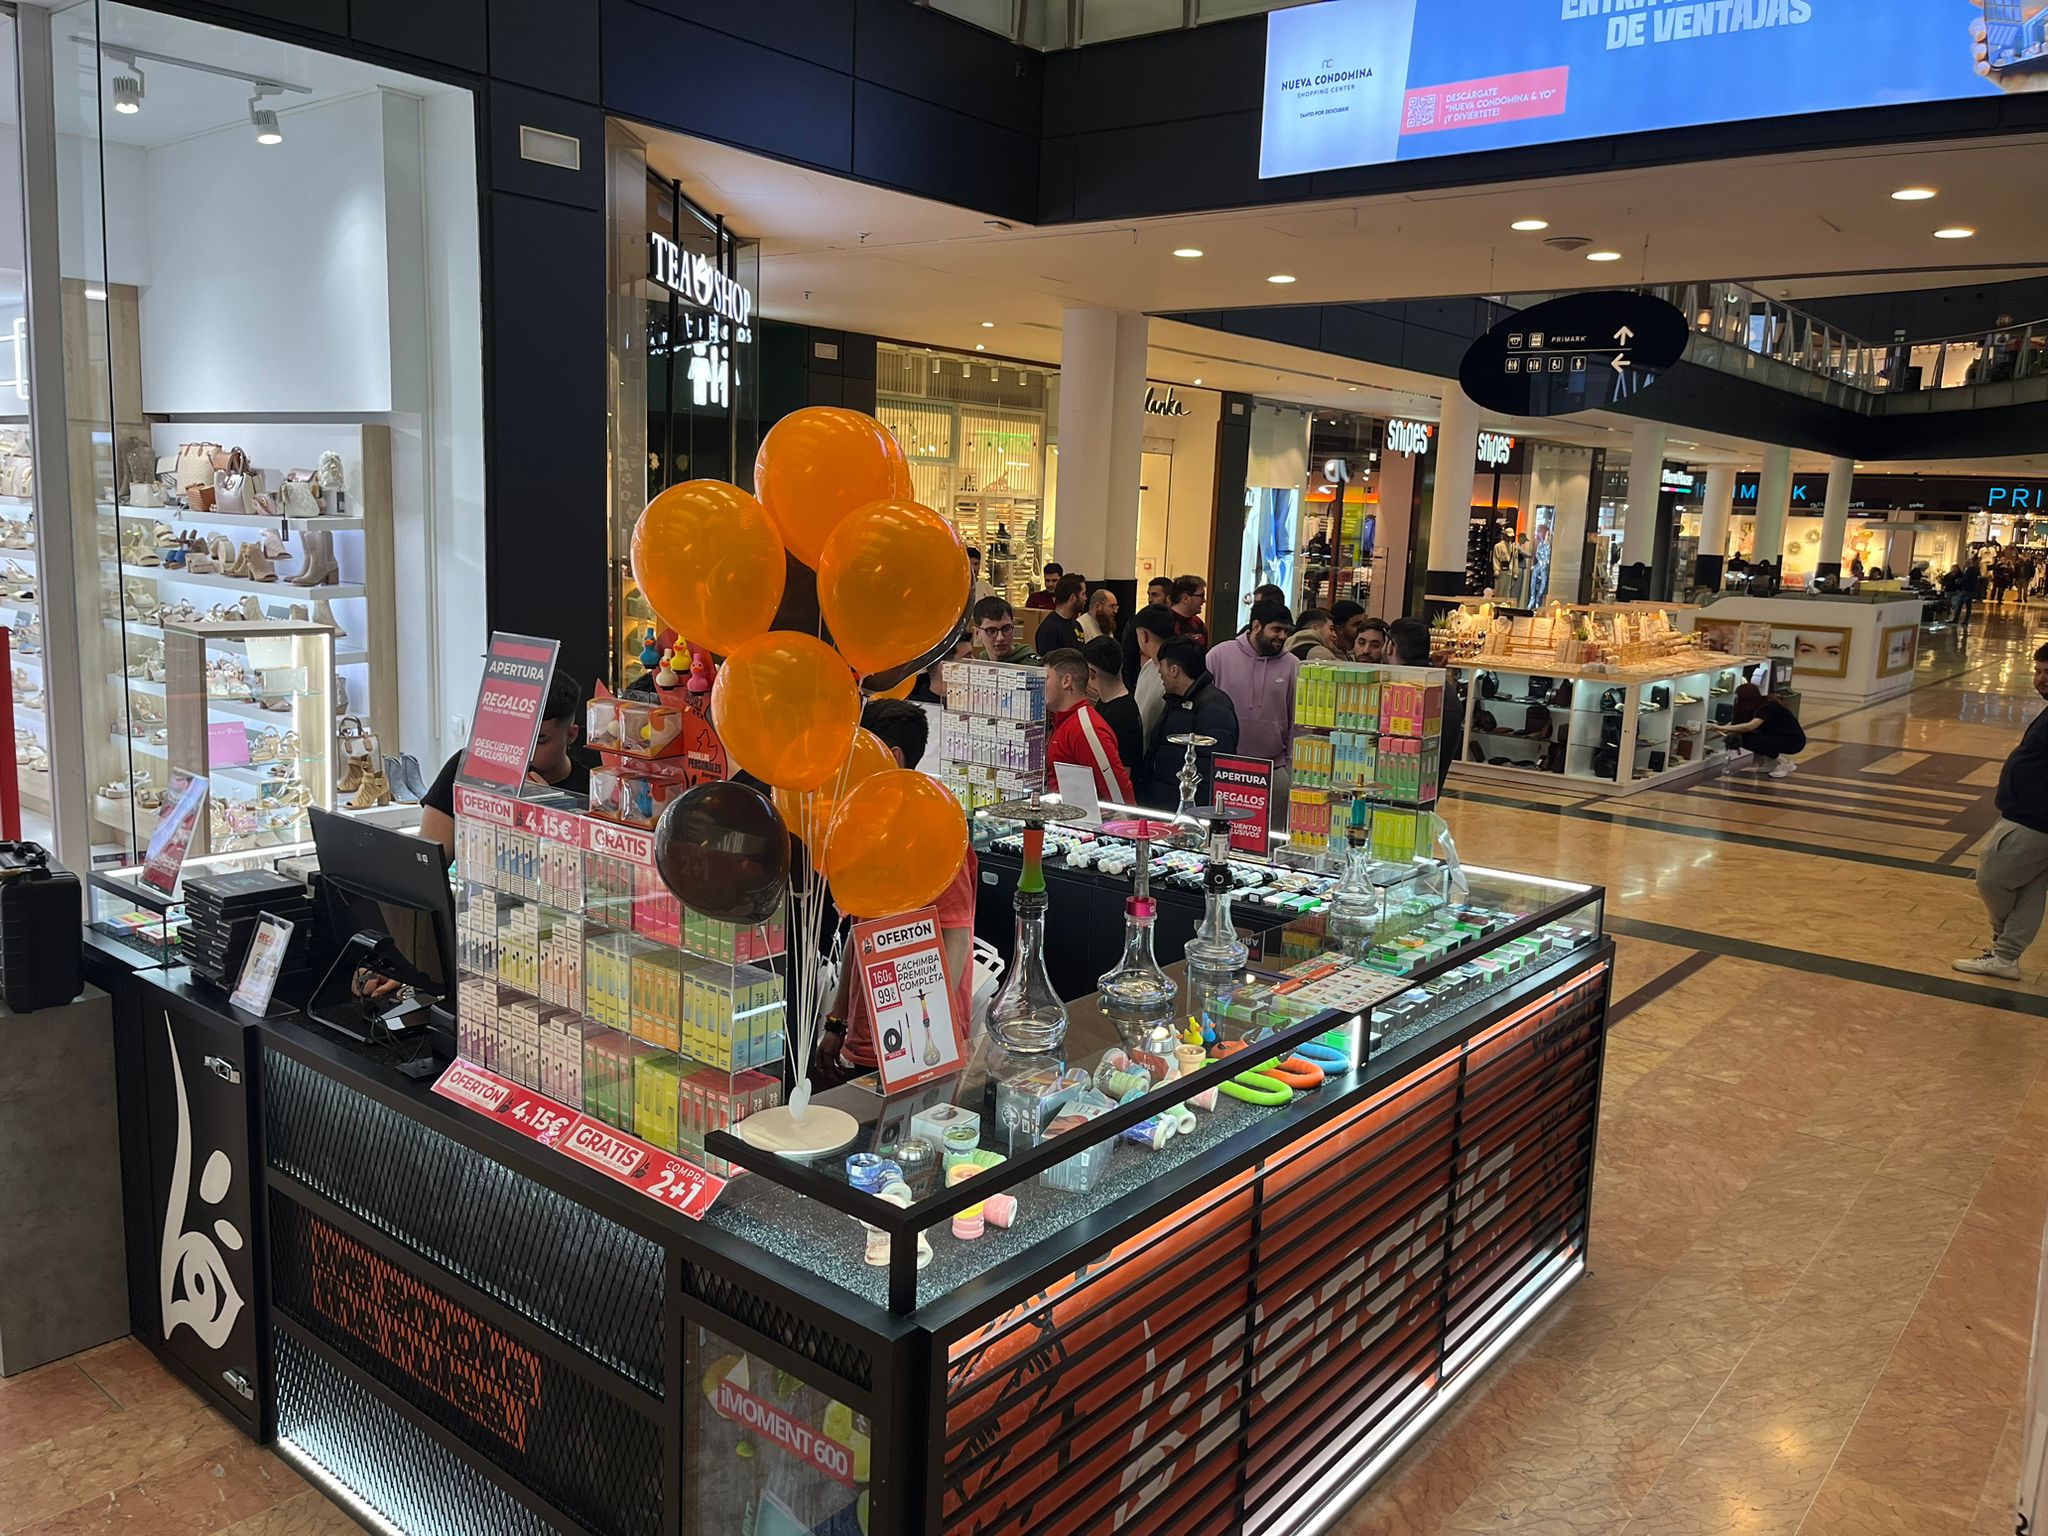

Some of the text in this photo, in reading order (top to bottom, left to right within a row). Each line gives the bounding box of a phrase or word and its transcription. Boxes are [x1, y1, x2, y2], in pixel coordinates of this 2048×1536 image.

[1606, 12, 1647, 51] DE
[1653, 0, 1812, 44] VENTAJAS
[1281, 67, 1373, 91] NUEVA CONDOMINA
[1297, 84, 1356, 99] SHOPPING CENTER
[1446, 87, 1498, 103] DESCÁRGATE
[1476, 94, 1529, 109] CONDOMINA
[1300, 111, 1315, 119] TANTO
[1315, 109, 1325, 117] POR
[652, 231, 752, 327] TEA SHOP
[1551, 335, 1587, 344] PRIMARK
[488, 661, 545, 681] APERTURA
[481, 691, 537, 713] REGALOS
[474, 737, 525, 756] DESCUENTOS
[474, 747, 521, 766] EXCLUSIVOS
[1215, 770, 1267, 786] APERTURA
[463, 795, 511, 818] OFERTÓN
[1215, 790, 1266, 807] REGALOS
[594, 828, 647, 857] GRATIS
[1231, 828, 1260, 839] LUSIVOS
[876, 923, 932, 947] OFERTÓN
[896, 953, 940, 973] CACHIMBA
[897, 965, 937, 983] PREMIUM
[900, 972, 945, 992] COMPLETA
[449, 1069, 504, 1104] OFERTÓN
[575, 1127, 640, 1168] GRATIS
[666, 1160, 706, 1186] COMPRA
[647, 1170, 703, 1210] 2+1
[813, 1438, 849, 1477] 600
